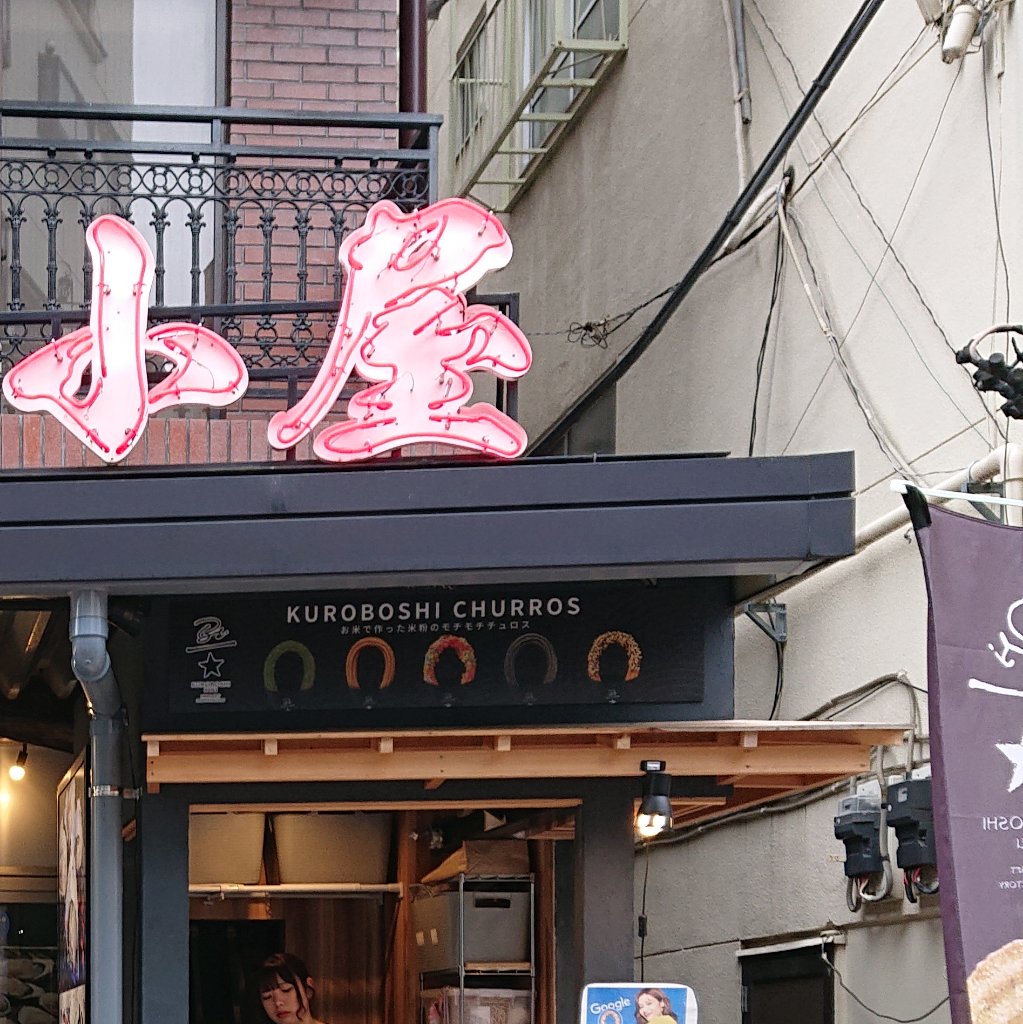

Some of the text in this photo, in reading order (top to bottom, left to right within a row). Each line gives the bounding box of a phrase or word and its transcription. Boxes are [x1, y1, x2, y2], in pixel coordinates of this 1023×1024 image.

[287, 597, 581, 623] KUROBOSHI CHURROS
[340, 620, 531, 635] お米で作った米粉のモチモチチュロス
[590, 996, 631, 1015] Google
